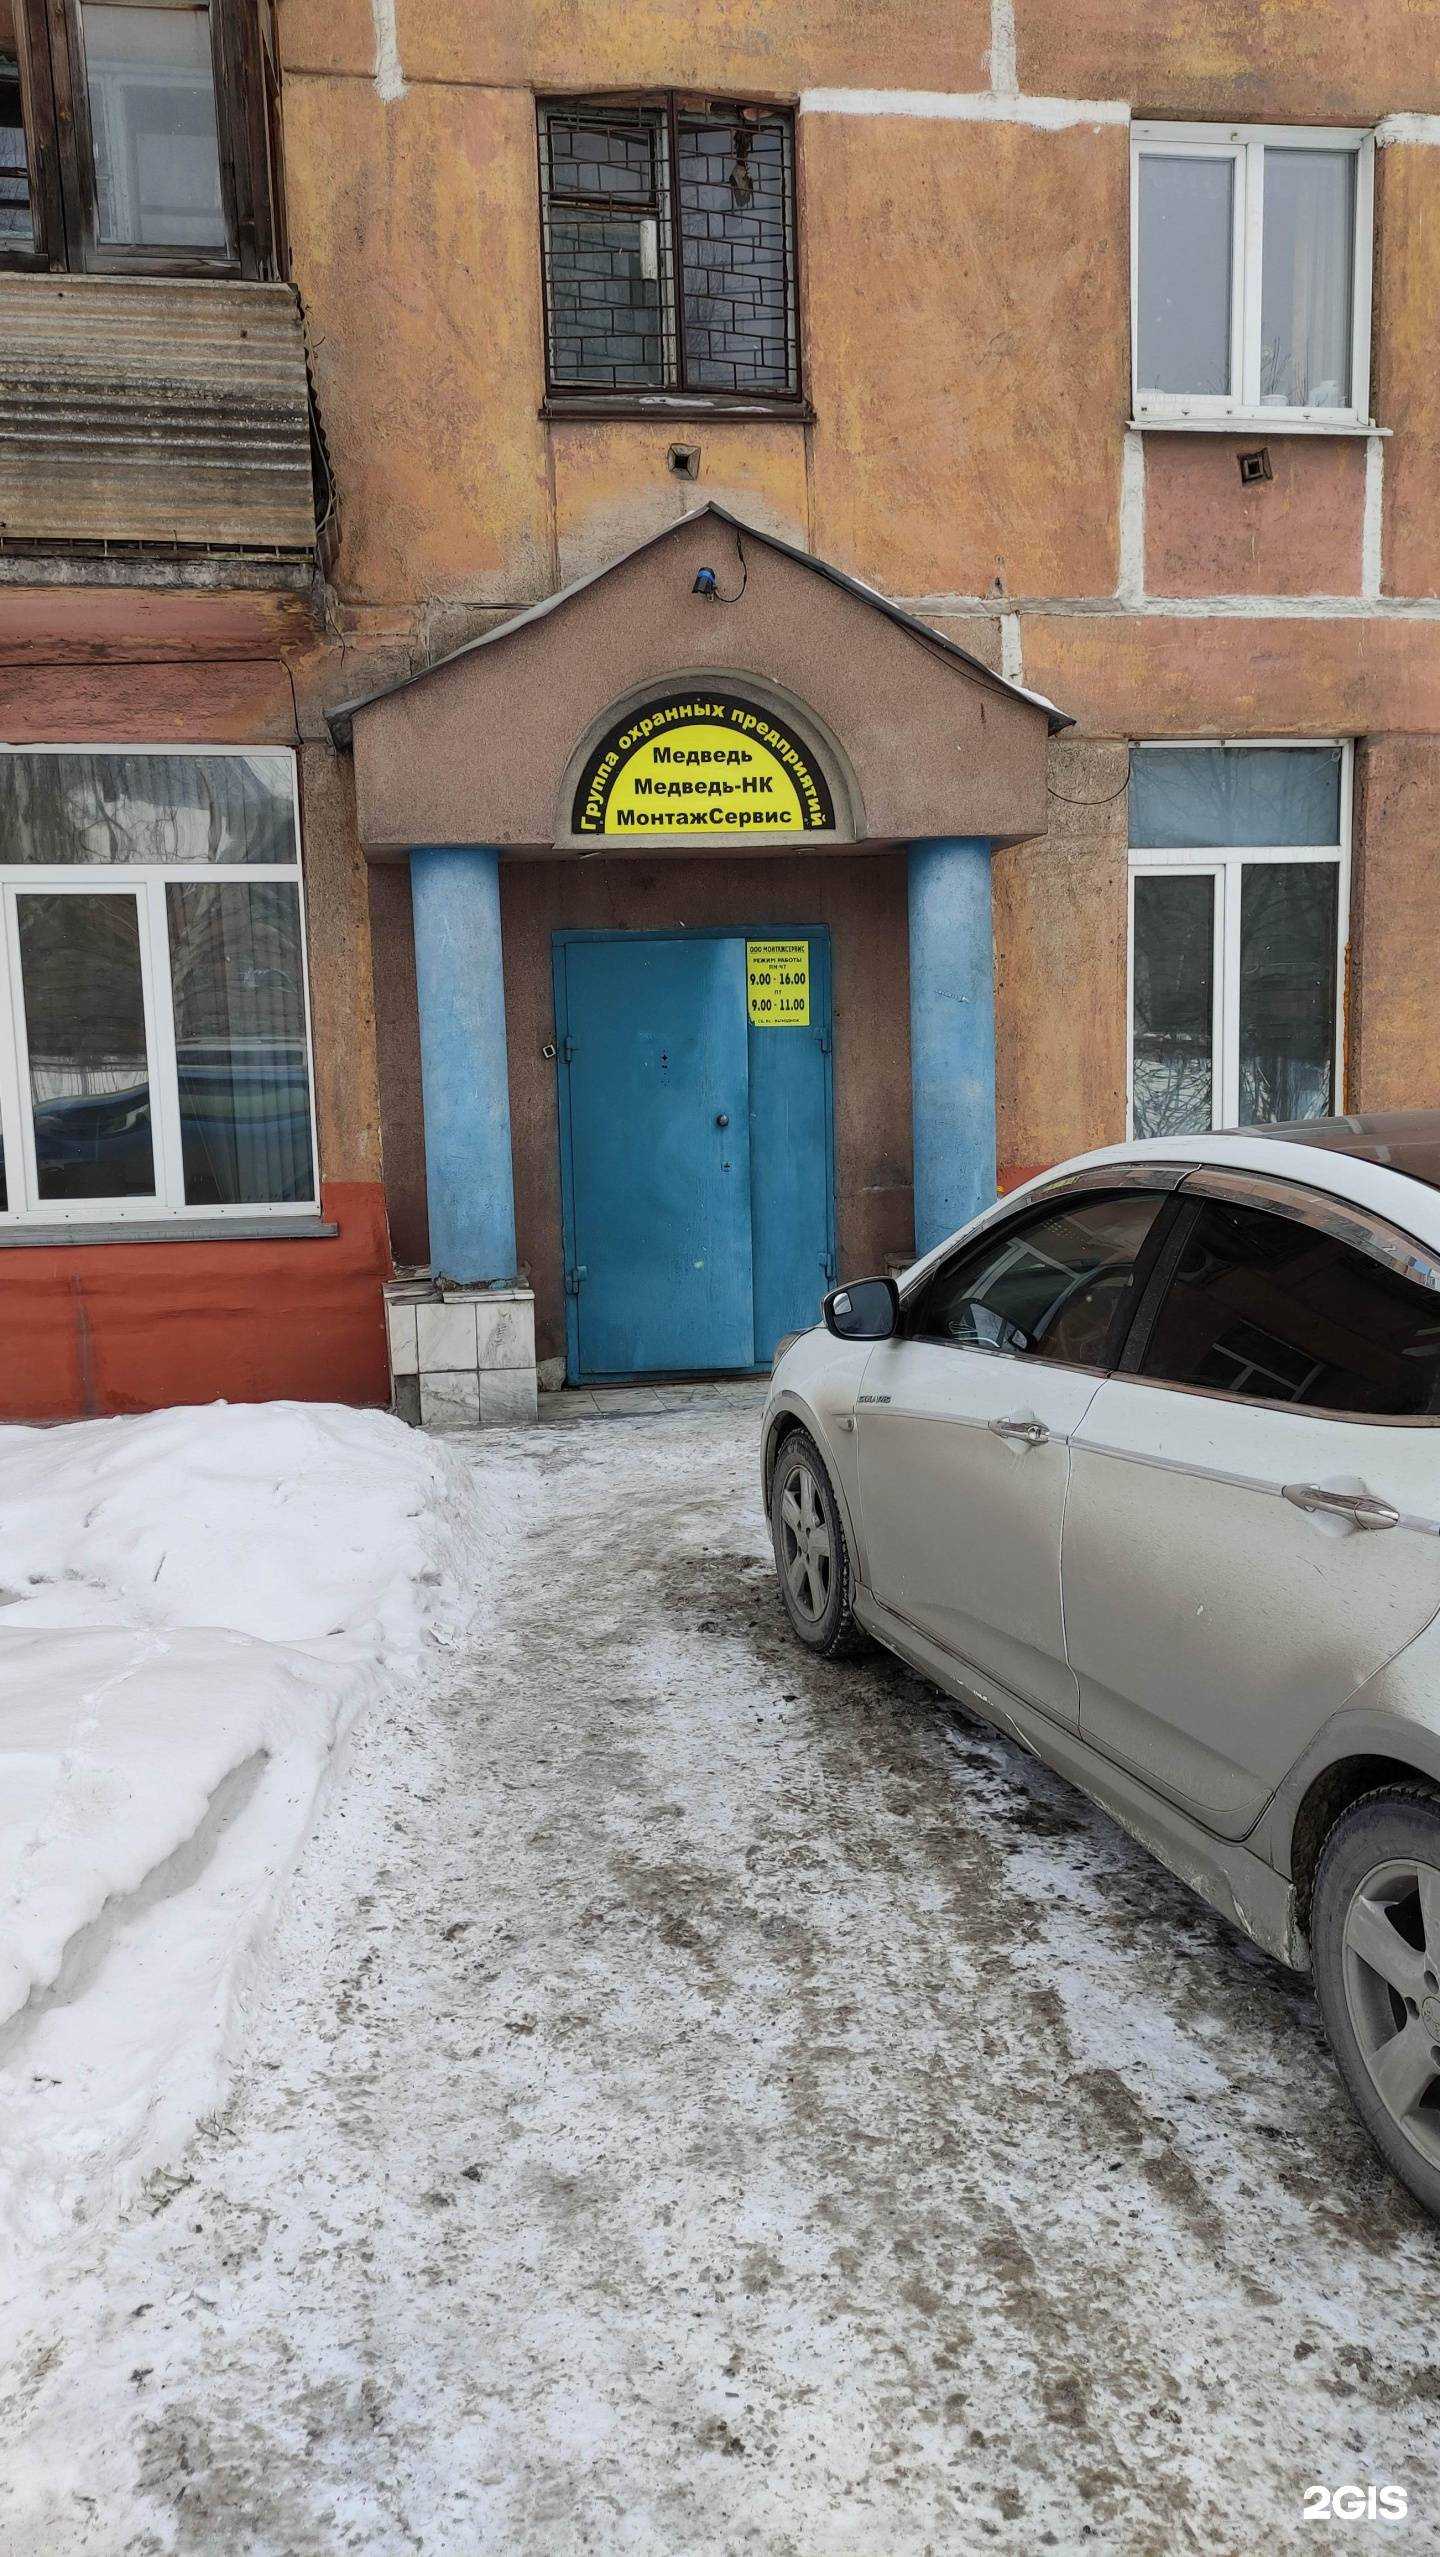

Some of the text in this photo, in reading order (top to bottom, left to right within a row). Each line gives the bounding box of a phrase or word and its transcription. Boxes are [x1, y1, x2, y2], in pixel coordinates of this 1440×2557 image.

[653, 746, 753, 765] Медведь
[581, 702, 827, 831] Группа охранных предприятий
[634, 776, 773, 796] Медведь-НК
[617, 807, 792, 826] МонтажСервис
[750, 973, 771, 985] 9.00
[780, 973, 806, 984] 16.00
[752, 999, 771, 1011] 9.00
[780, 999, 804, 1010] 11.00
